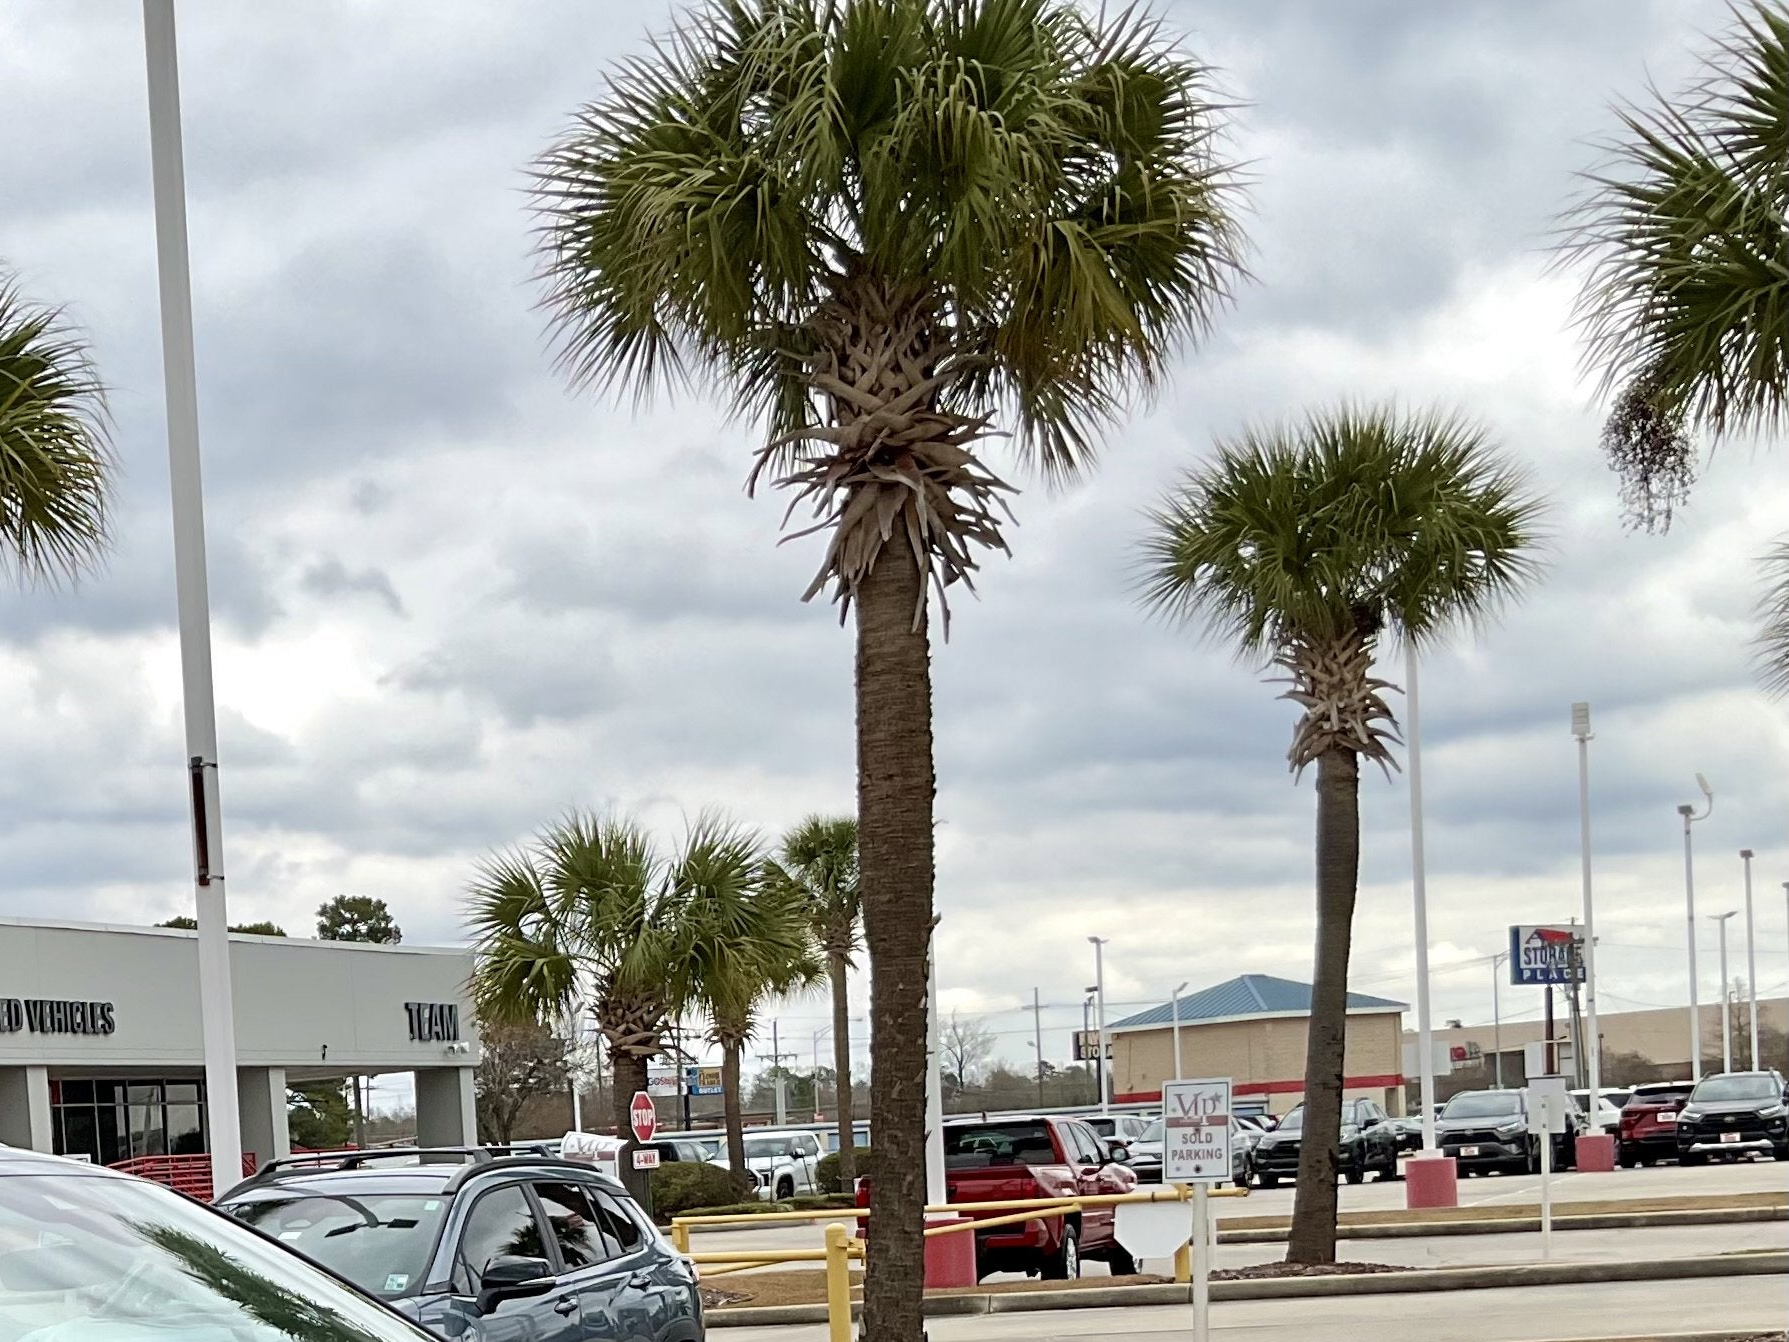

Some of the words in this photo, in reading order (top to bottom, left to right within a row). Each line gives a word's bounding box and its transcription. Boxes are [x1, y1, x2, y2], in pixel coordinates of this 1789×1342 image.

[1523, 946, 1584, 965] STORAE
[1522, 968, 1584, 980] PLACE
[24, 1000, 115, 1034] VEHICLES
[404, 1002, 460, 1041] TEAM
[632, 1108, 654, 1127] STOP
[1181, 1132, 1213, 1145] SOLD
[636, 1153, 656, 1166] 4-WAY
[1171, 1147, 1223, 1161] PARKING
